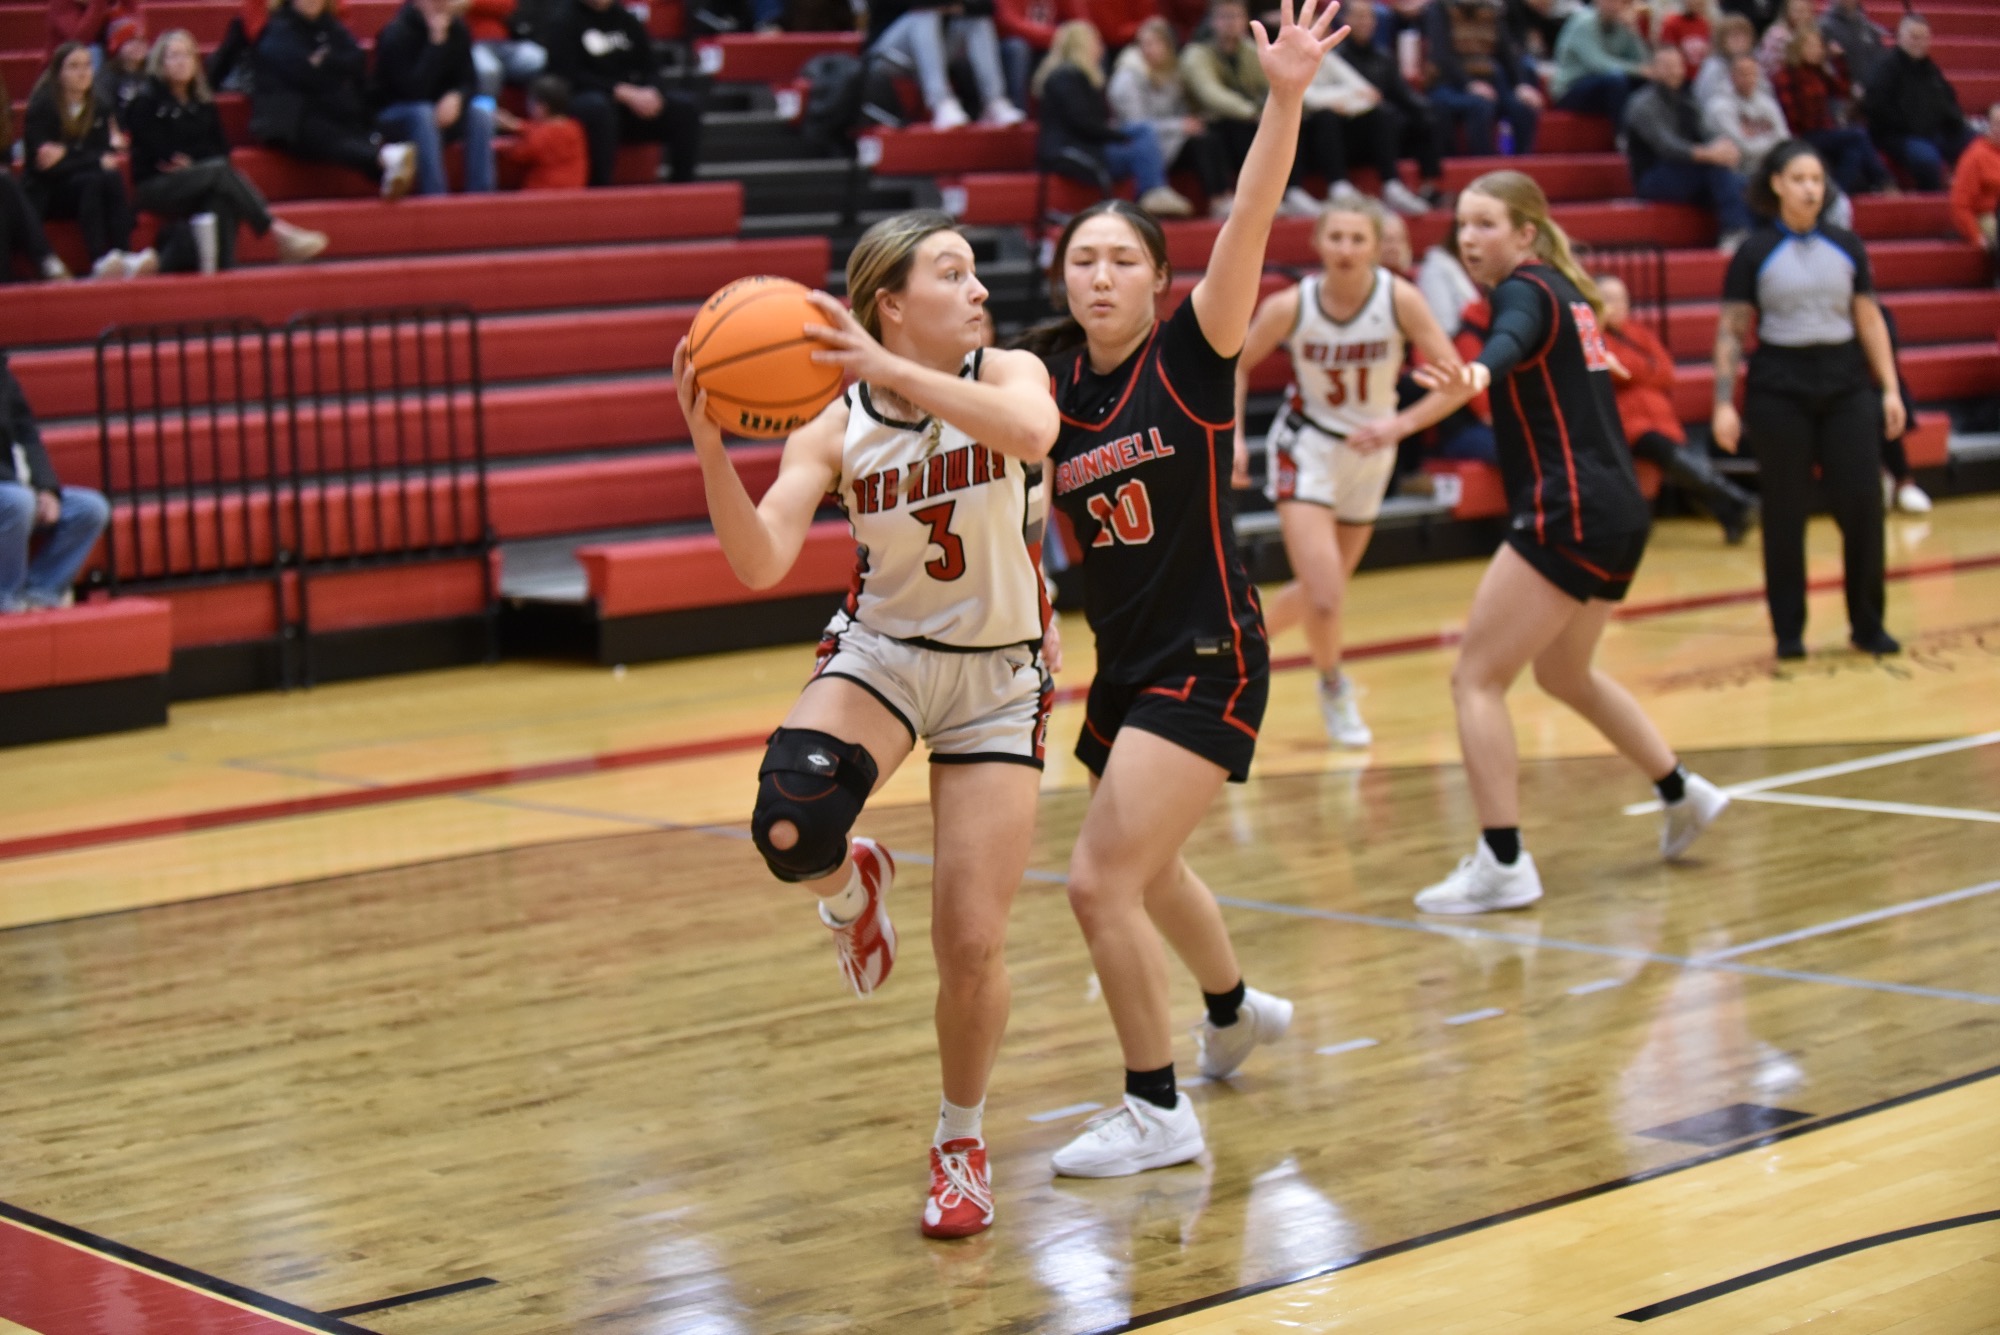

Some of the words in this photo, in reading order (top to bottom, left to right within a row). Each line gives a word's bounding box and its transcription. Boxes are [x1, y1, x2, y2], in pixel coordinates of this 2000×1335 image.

[1325, 367, 1369, 407] 31
[852, 468, 900, 515] RED
[906, 442, 1006, 504] HAWKS
[1087, 478, 1155, 548] 10
[909, 499, 966, 582] 3
